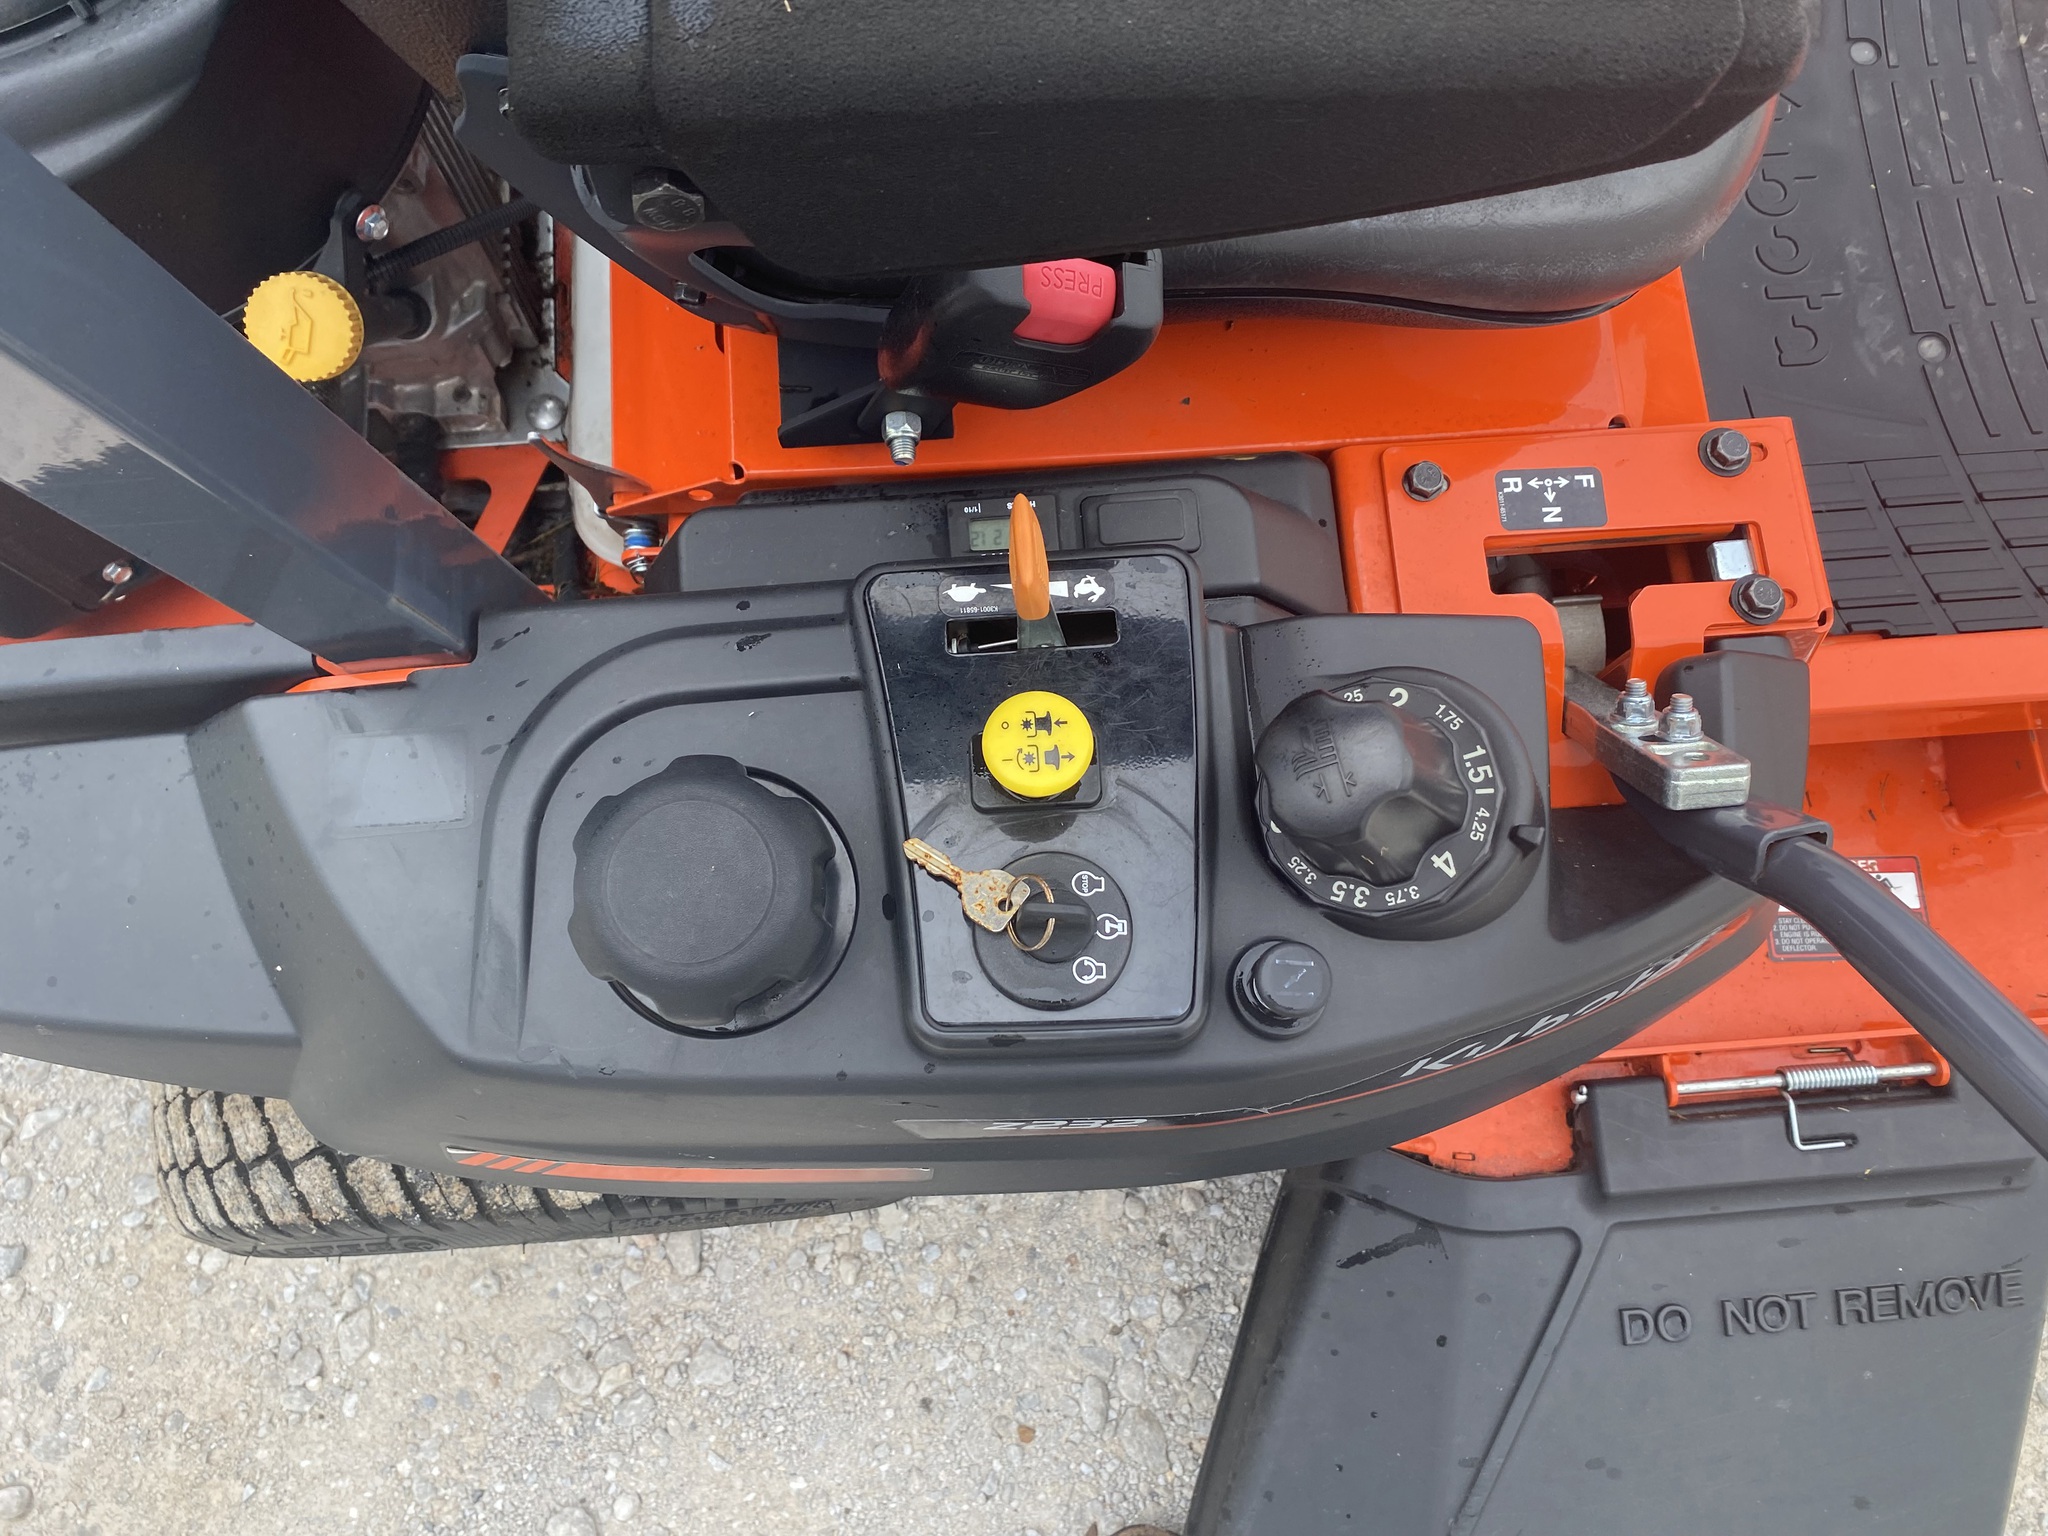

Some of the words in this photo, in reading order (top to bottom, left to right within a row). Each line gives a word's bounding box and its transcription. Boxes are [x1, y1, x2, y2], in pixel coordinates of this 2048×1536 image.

[1041, 265, 1103, 298] PRESS
[1502, 477, 1522, 493] R
[1574, 474, 1596, 488] F
[1541, 506, 1563, 523] N
[960, 604, 999, 614] K3001-65811
[1435, 704, 1463, 731] 1.75
[1463, 745, 1493, 783] 1.5
[1470, 807, 1490, 841] 4.25
[1287, 856, 1317, 884] 3.25
[1431, 851, 1456, 878] 4
[1330, 881, 1370, 908] 3.5
[1385, 886, 1420, 906] 3.75
[1619, 1303, 1692, 1346] DO
[1721, 1291, 1817, 1337] NOT
[1835, 1269, 2026, 1326] REMOVE
